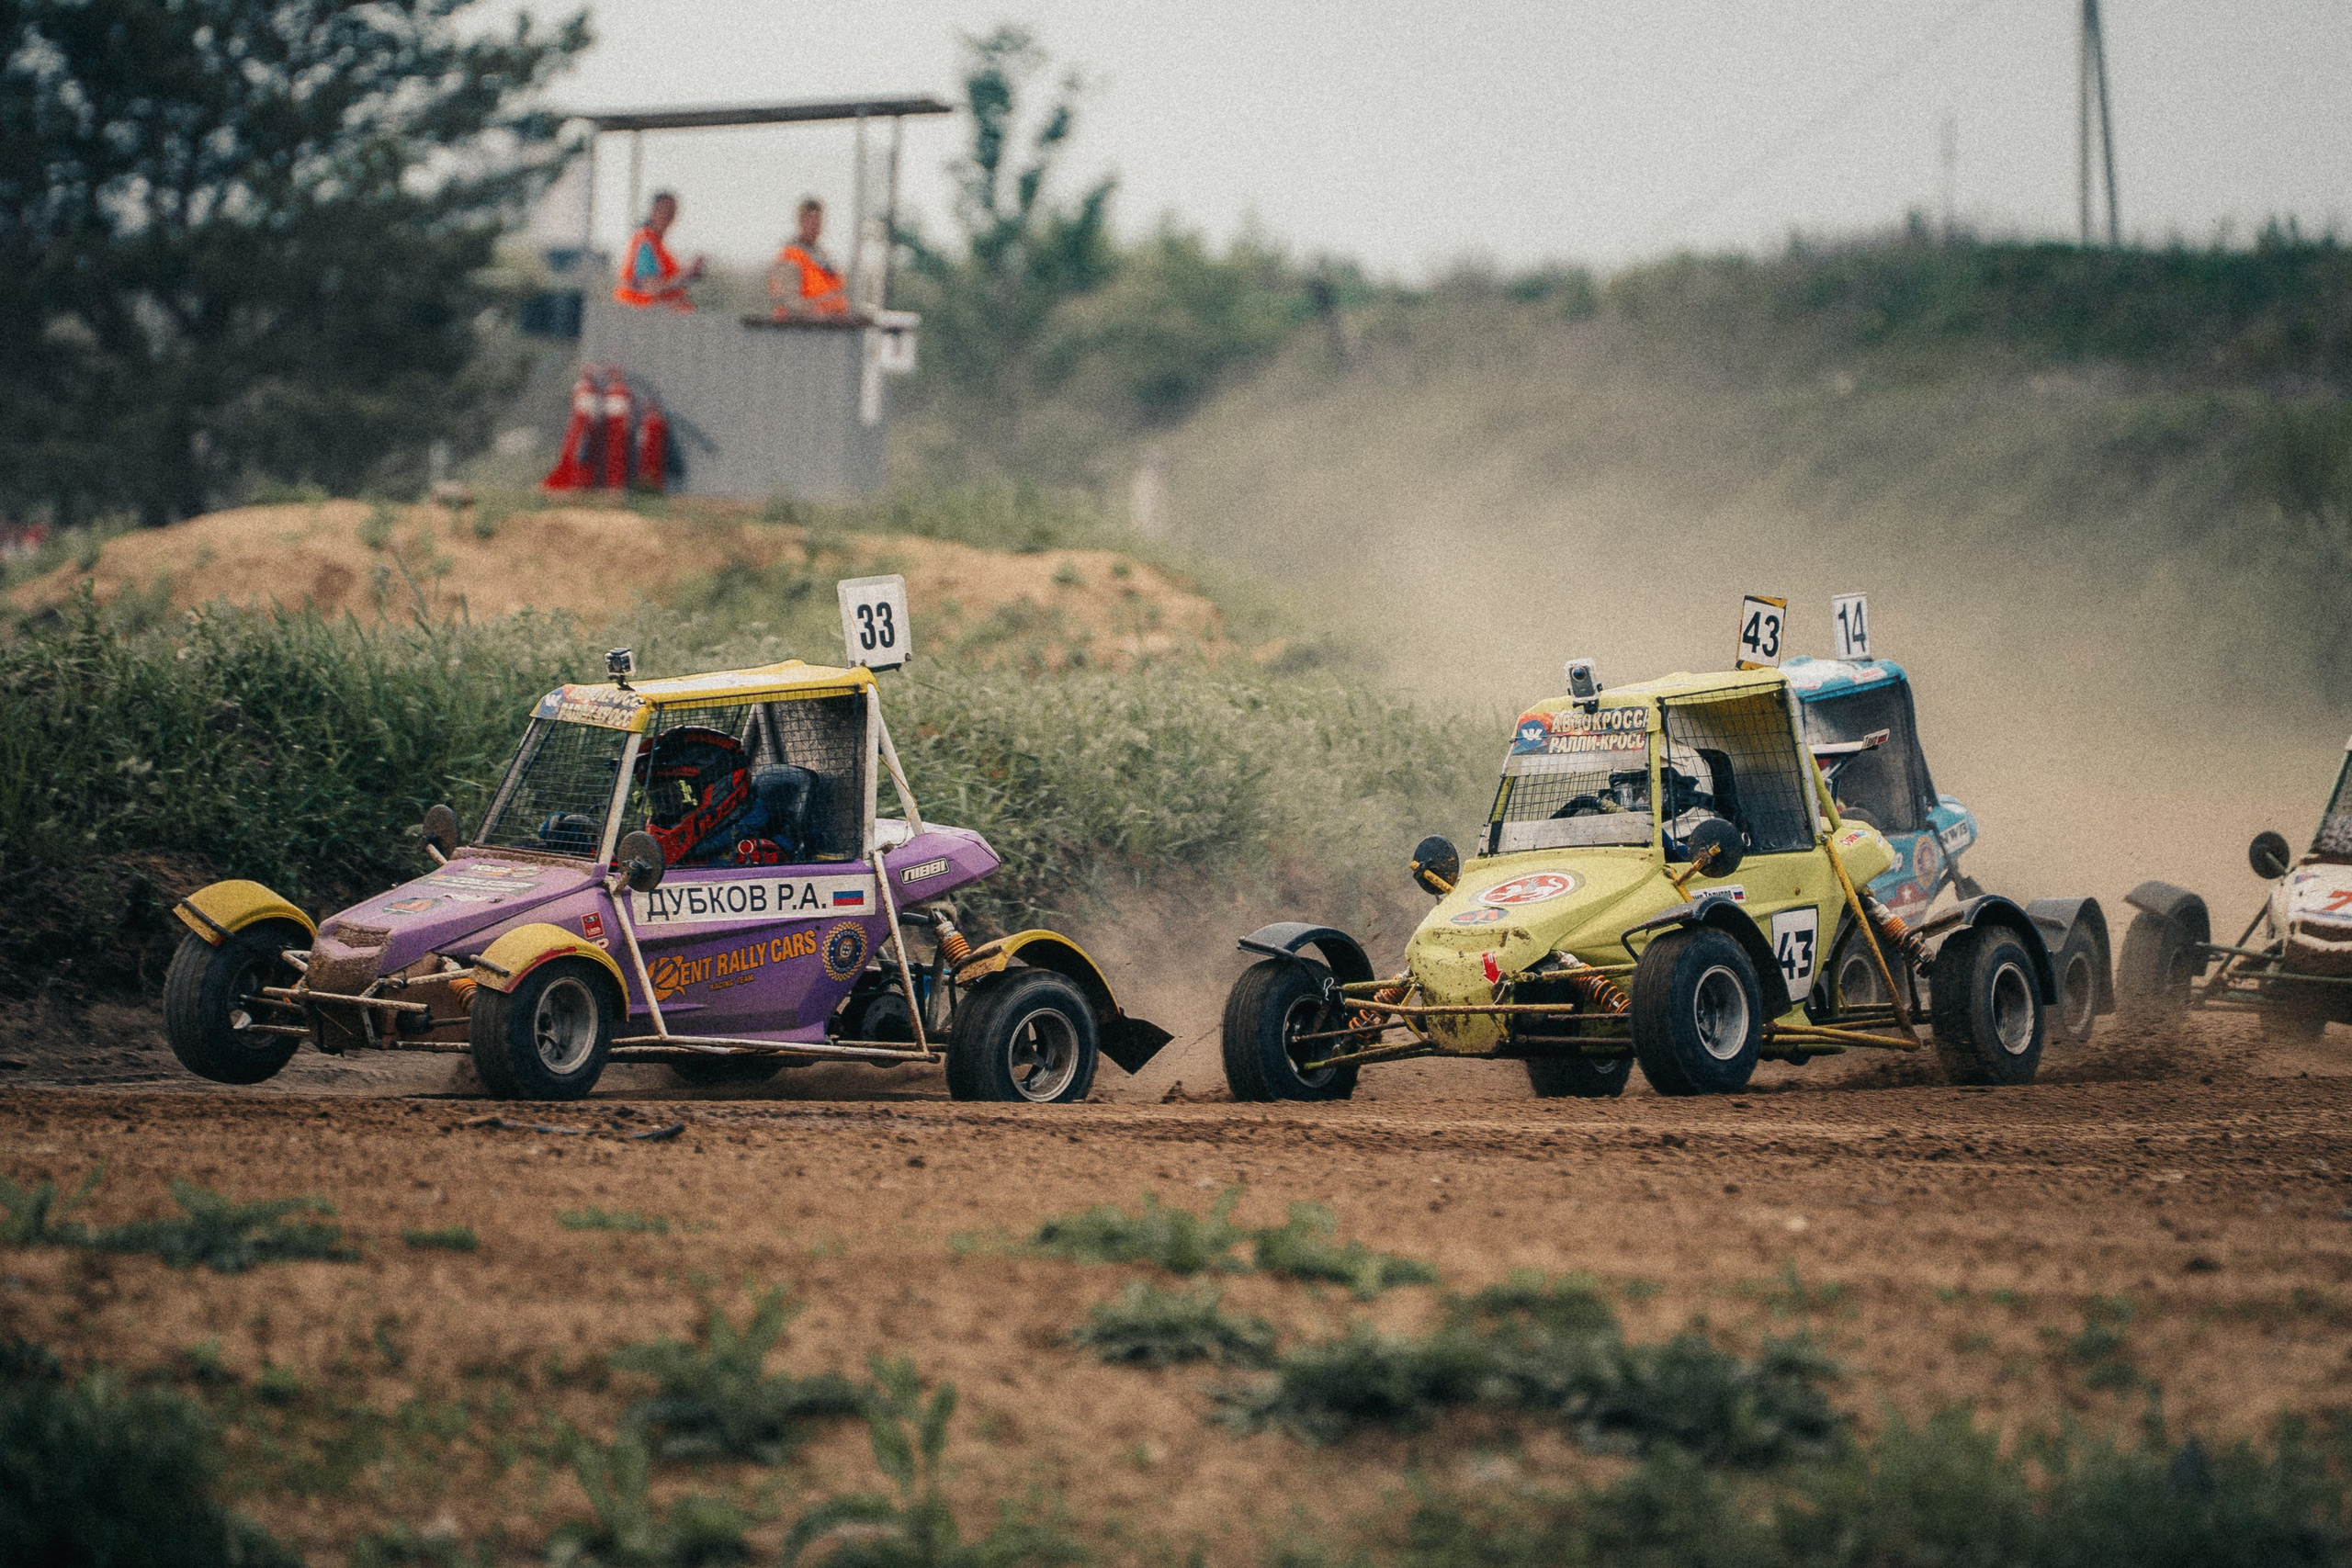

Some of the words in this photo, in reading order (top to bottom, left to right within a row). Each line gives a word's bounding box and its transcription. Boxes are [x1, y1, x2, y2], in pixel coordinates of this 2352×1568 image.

[857, 602, 895, 650] 33
[1742, 611, 1780, 658] 43
[1838, 602, 1866, 655] 14
[646, 885, 768, 922] ДУБКОВ
[777, 882, 827, 911] Р.А.
[717, 942, 767, 977] RALLY
[770, 929, 818, 964] CARS
[1778, 929, 1814, 980] 43
